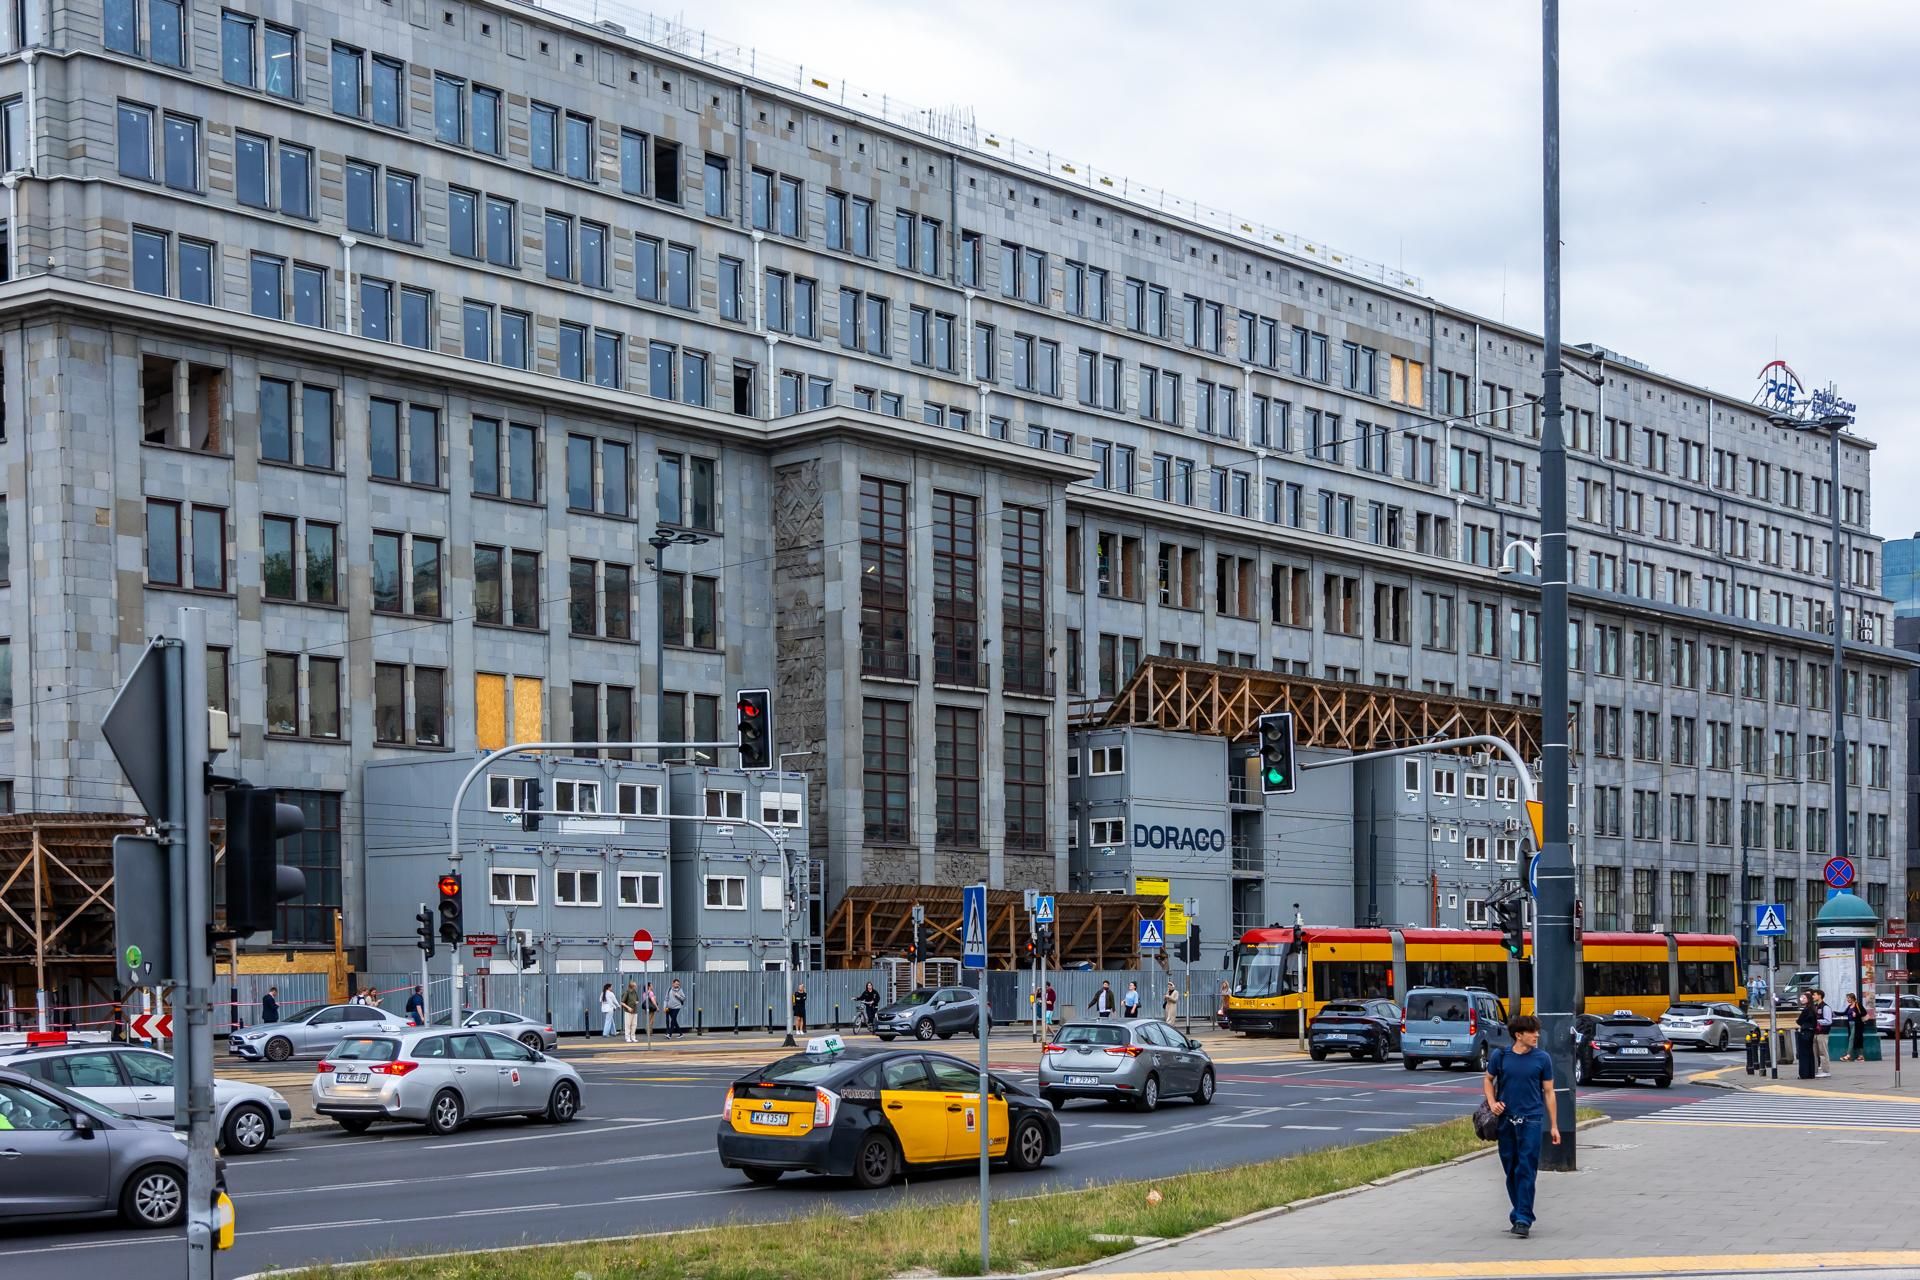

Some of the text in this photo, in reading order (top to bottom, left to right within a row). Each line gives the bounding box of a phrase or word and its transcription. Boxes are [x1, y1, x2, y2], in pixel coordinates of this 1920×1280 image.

[1134, 824, 1225, 852] DORACO
[1879, 939, 1914, 949] Nowy Świat
